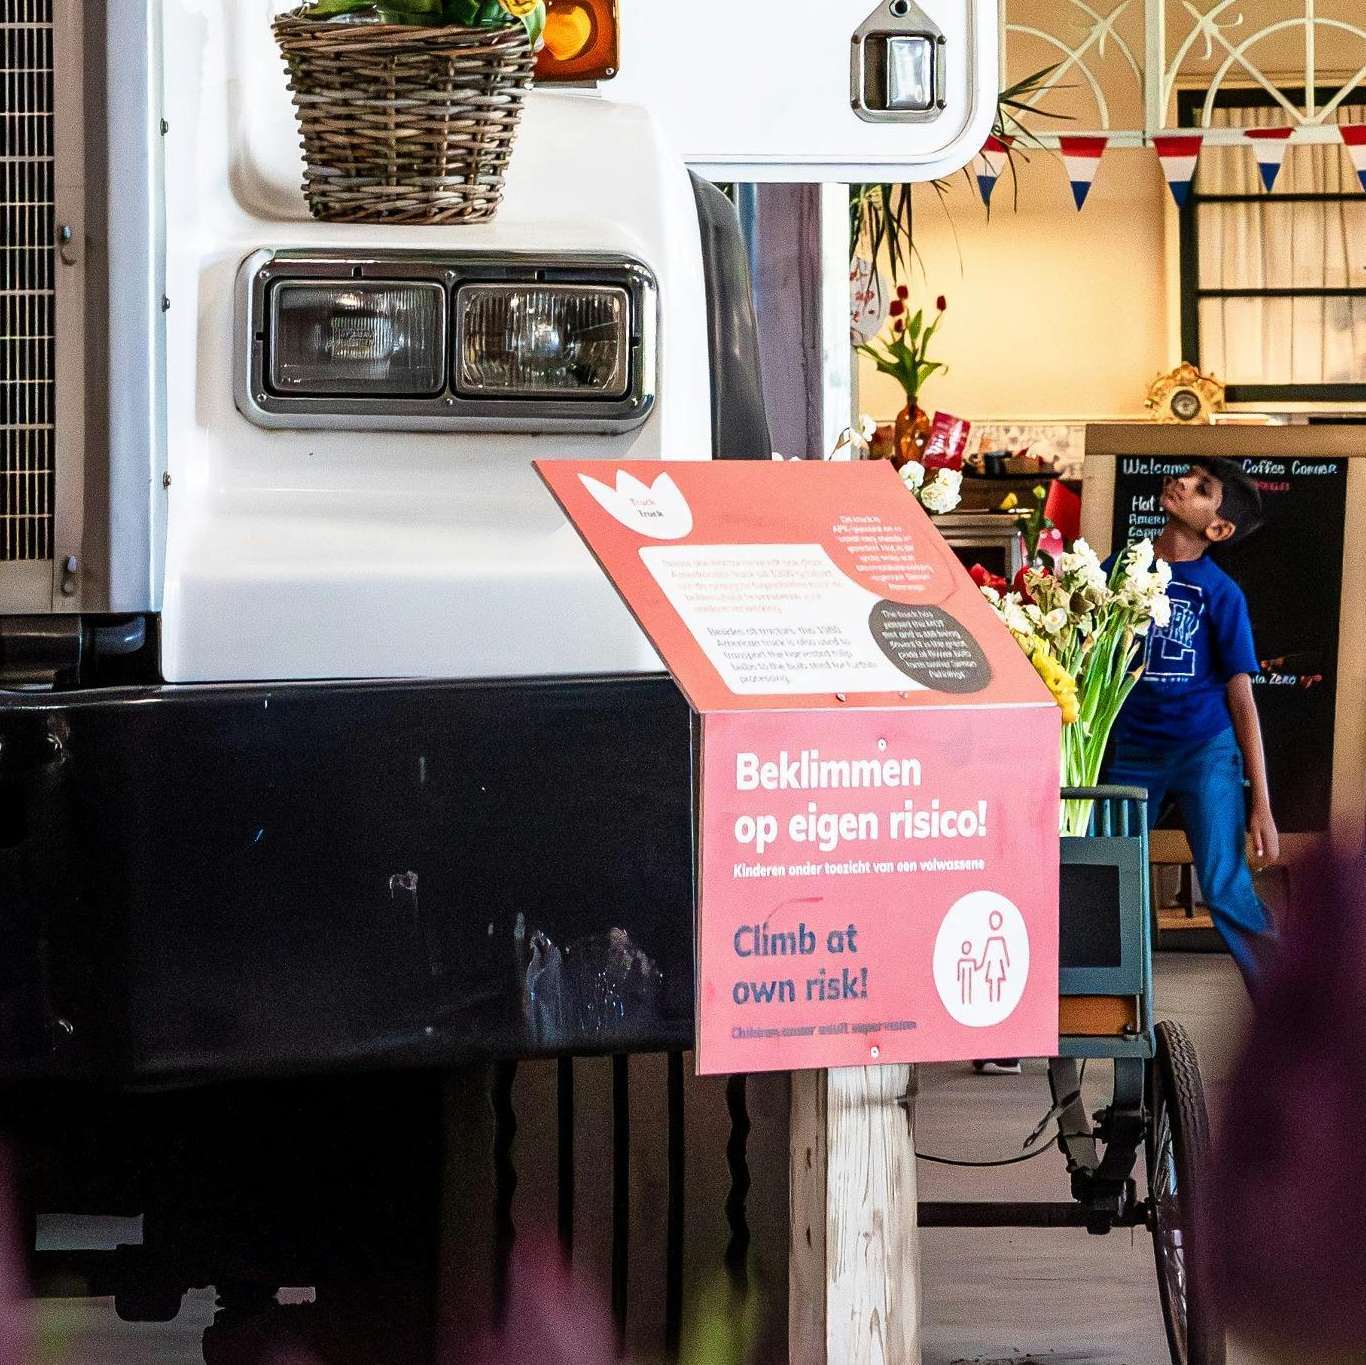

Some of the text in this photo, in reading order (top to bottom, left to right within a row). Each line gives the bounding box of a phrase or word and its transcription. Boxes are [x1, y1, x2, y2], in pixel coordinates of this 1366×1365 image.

[1242, 459, 1285, 475] Coffee
[1133, 496, 1155, 511] Hot
[736, 750, 921, 790] Beklimmen
[735, 799, 987, 853] op eigen risico!
[734, 858, 984, 878] Kinderen onder toezicht van een volwassene
[734, 923, 858, 957] Climb at
[733, 967, 868, 1004] own risk!
